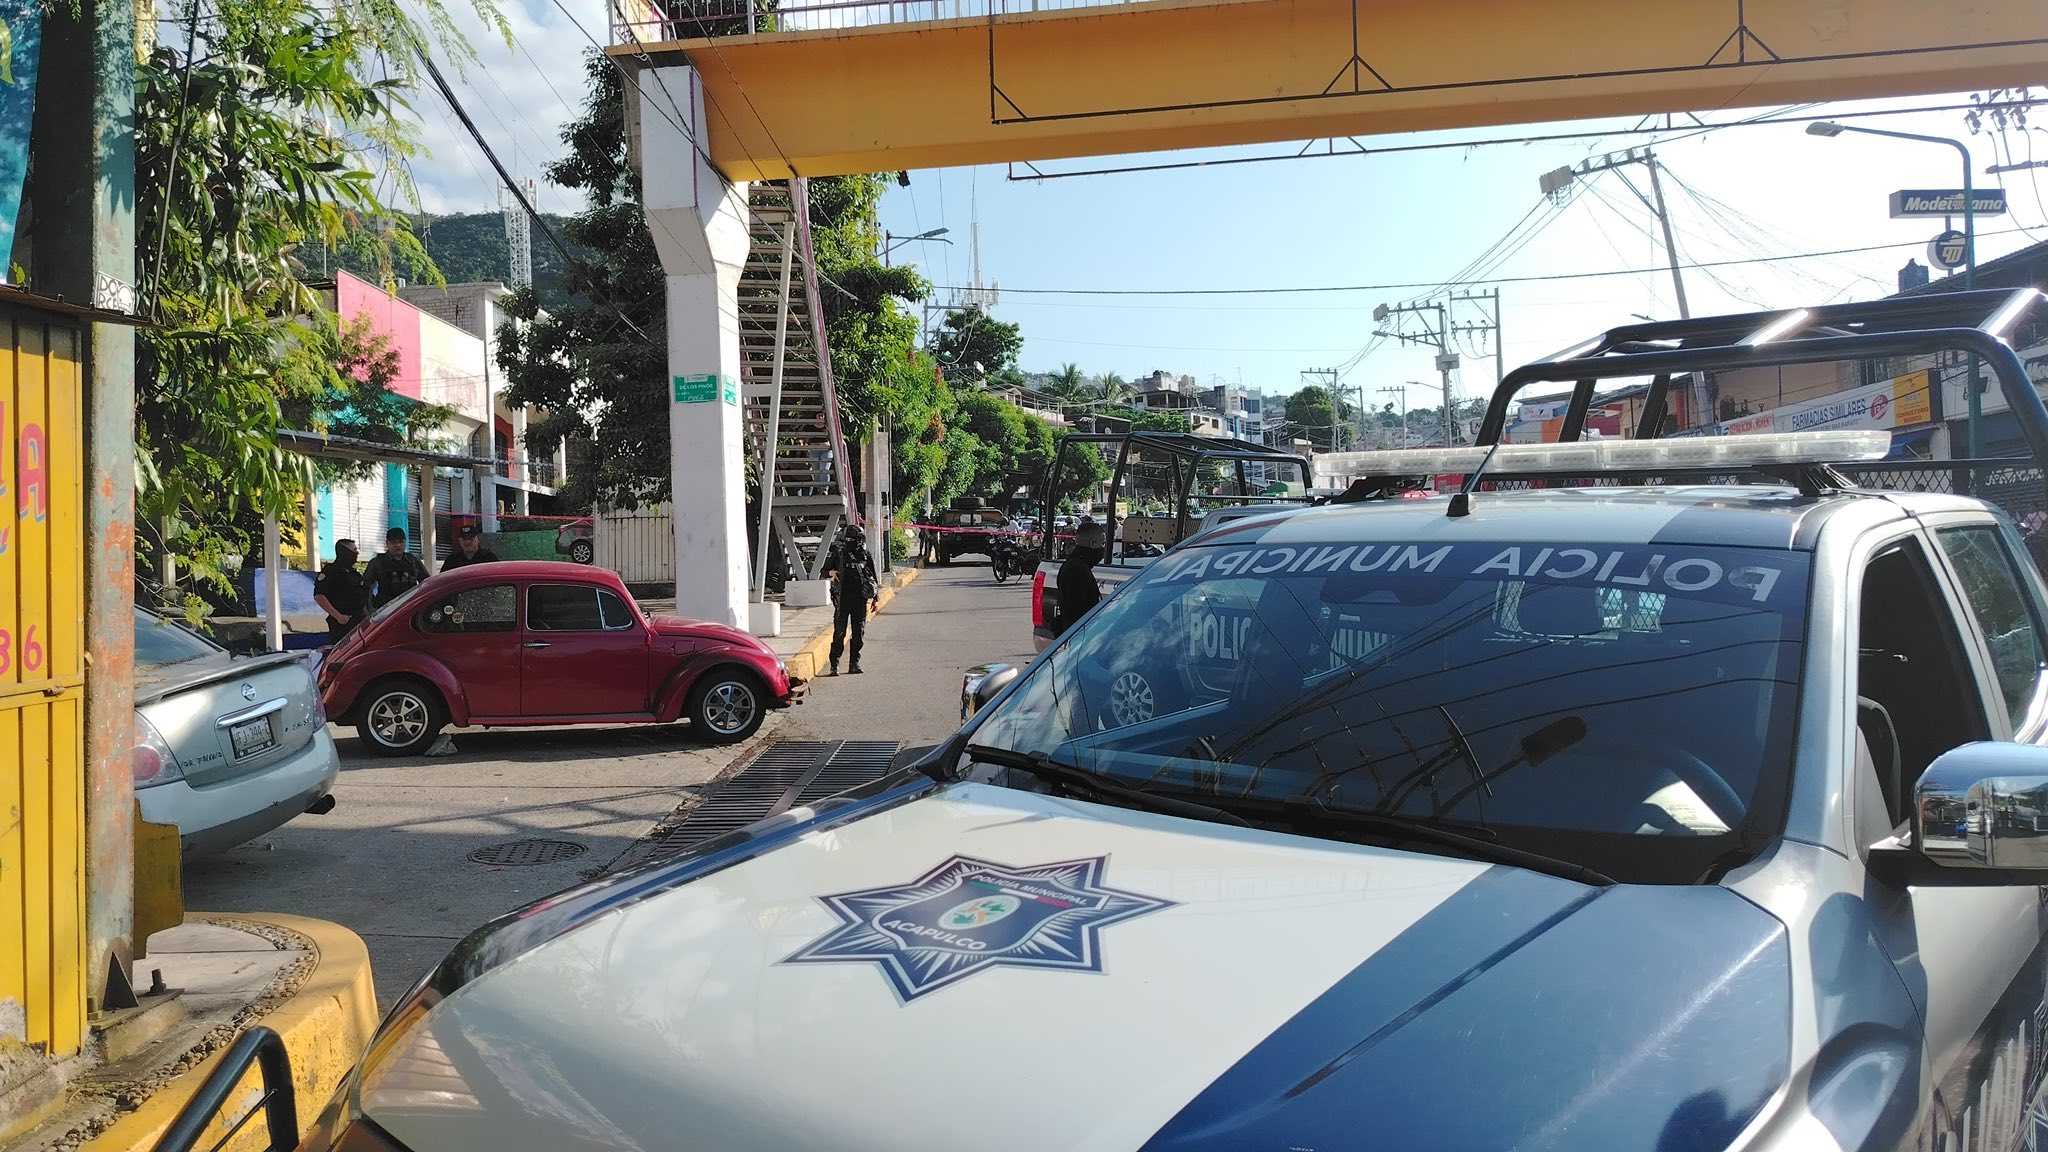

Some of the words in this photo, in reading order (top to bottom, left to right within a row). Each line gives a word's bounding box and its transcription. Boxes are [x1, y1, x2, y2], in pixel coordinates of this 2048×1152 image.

[1791, 407, 1829, 430] FARMACIAS
[1829, 398, 1867, 421] SIMILARES
[1020, 885, 1089, 906] MUNICIPAL
[883, 919, 987, 950] ACAPULCO
